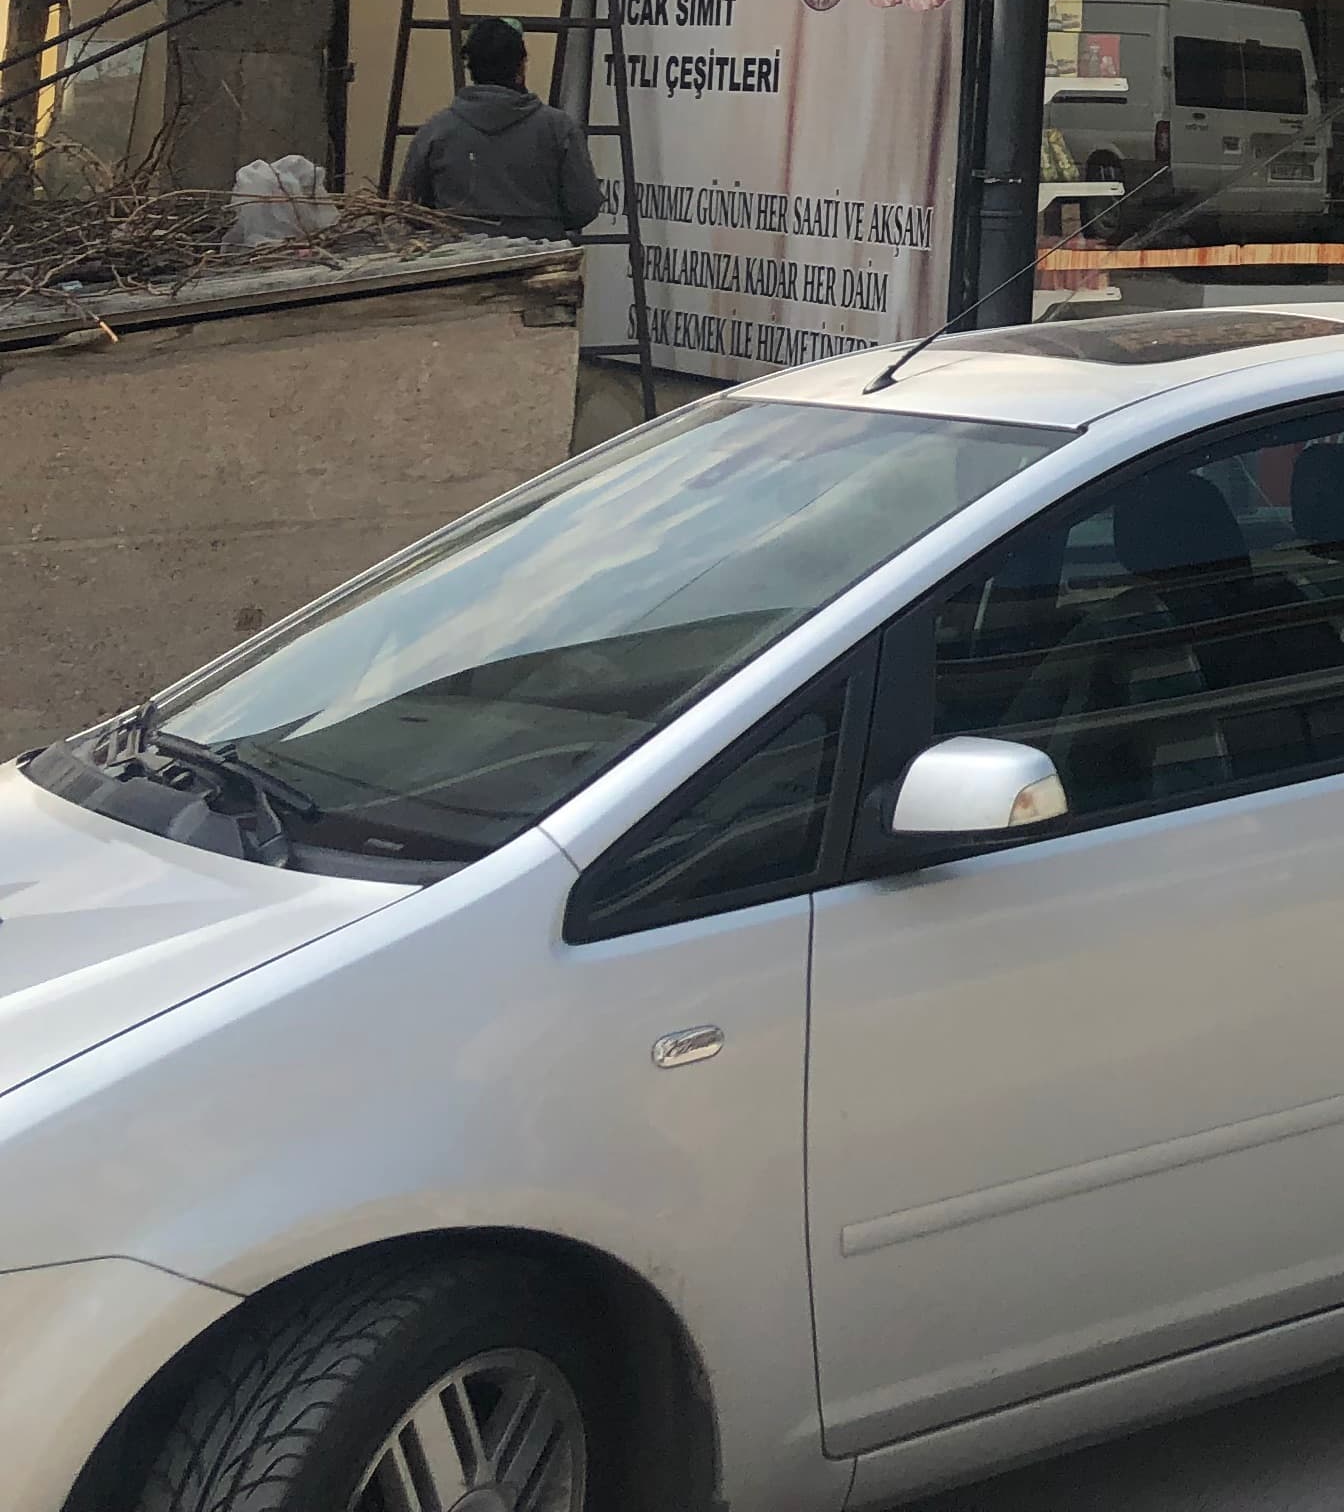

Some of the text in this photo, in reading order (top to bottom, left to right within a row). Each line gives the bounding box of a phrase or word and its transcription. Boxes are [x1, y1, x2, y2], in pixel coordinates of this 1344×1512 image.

[604, 48, 781, 100] TTLI ÇEŞİTLERİ
[622, 181, 694, 224] RINIMIZ
[697, 179, 753, 230] GÜNÜN
[755, 193, 789, 234] HER
[793, 189, 840, 239] SAATİ
[844, 201, 865, 242] VE
[867, 203, 933, 257] AKŞAM
[627, 245, 888, 313] FRALARINIZA KADAR HER DAİM
[627, 303, 879, 366] SAK EKMEK İLE HİZMETİNİZ
